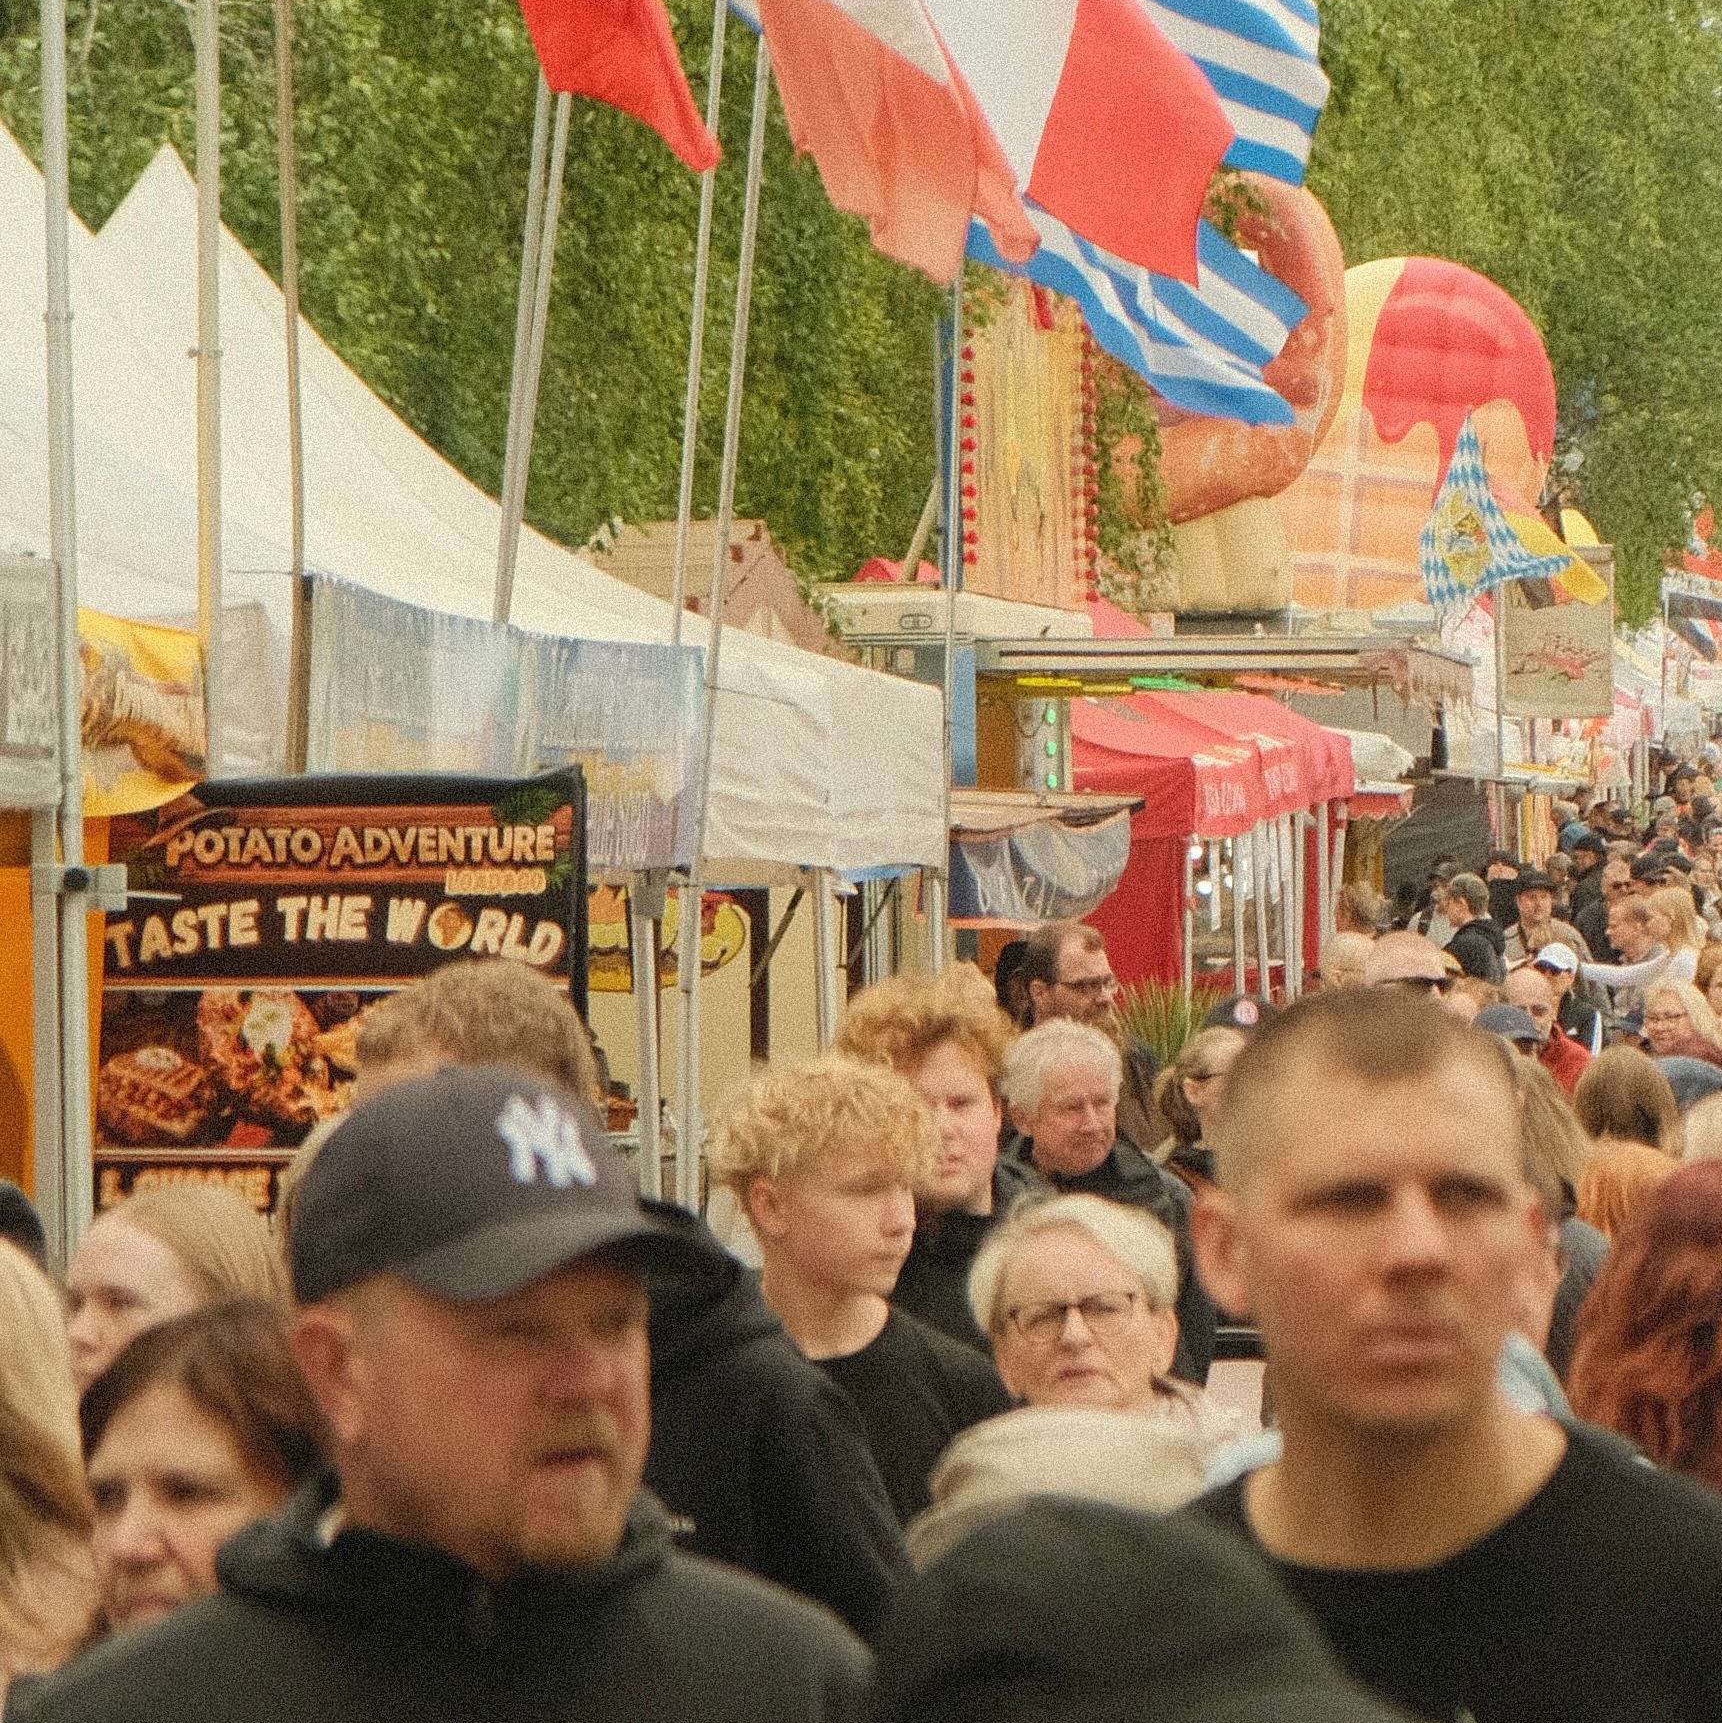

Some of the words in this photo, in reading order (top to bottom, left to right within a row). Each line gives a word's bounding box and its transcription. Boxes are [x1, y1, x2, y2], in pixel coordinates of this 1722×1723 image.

[166, 826, 324, 867] POTATO
[330, 824, 556, 868] ADVENTURE
[105, 899, 261, 968] TASTE
[278, 894, 373, 944] THE
[385, 897, 566, 966] WORLD
